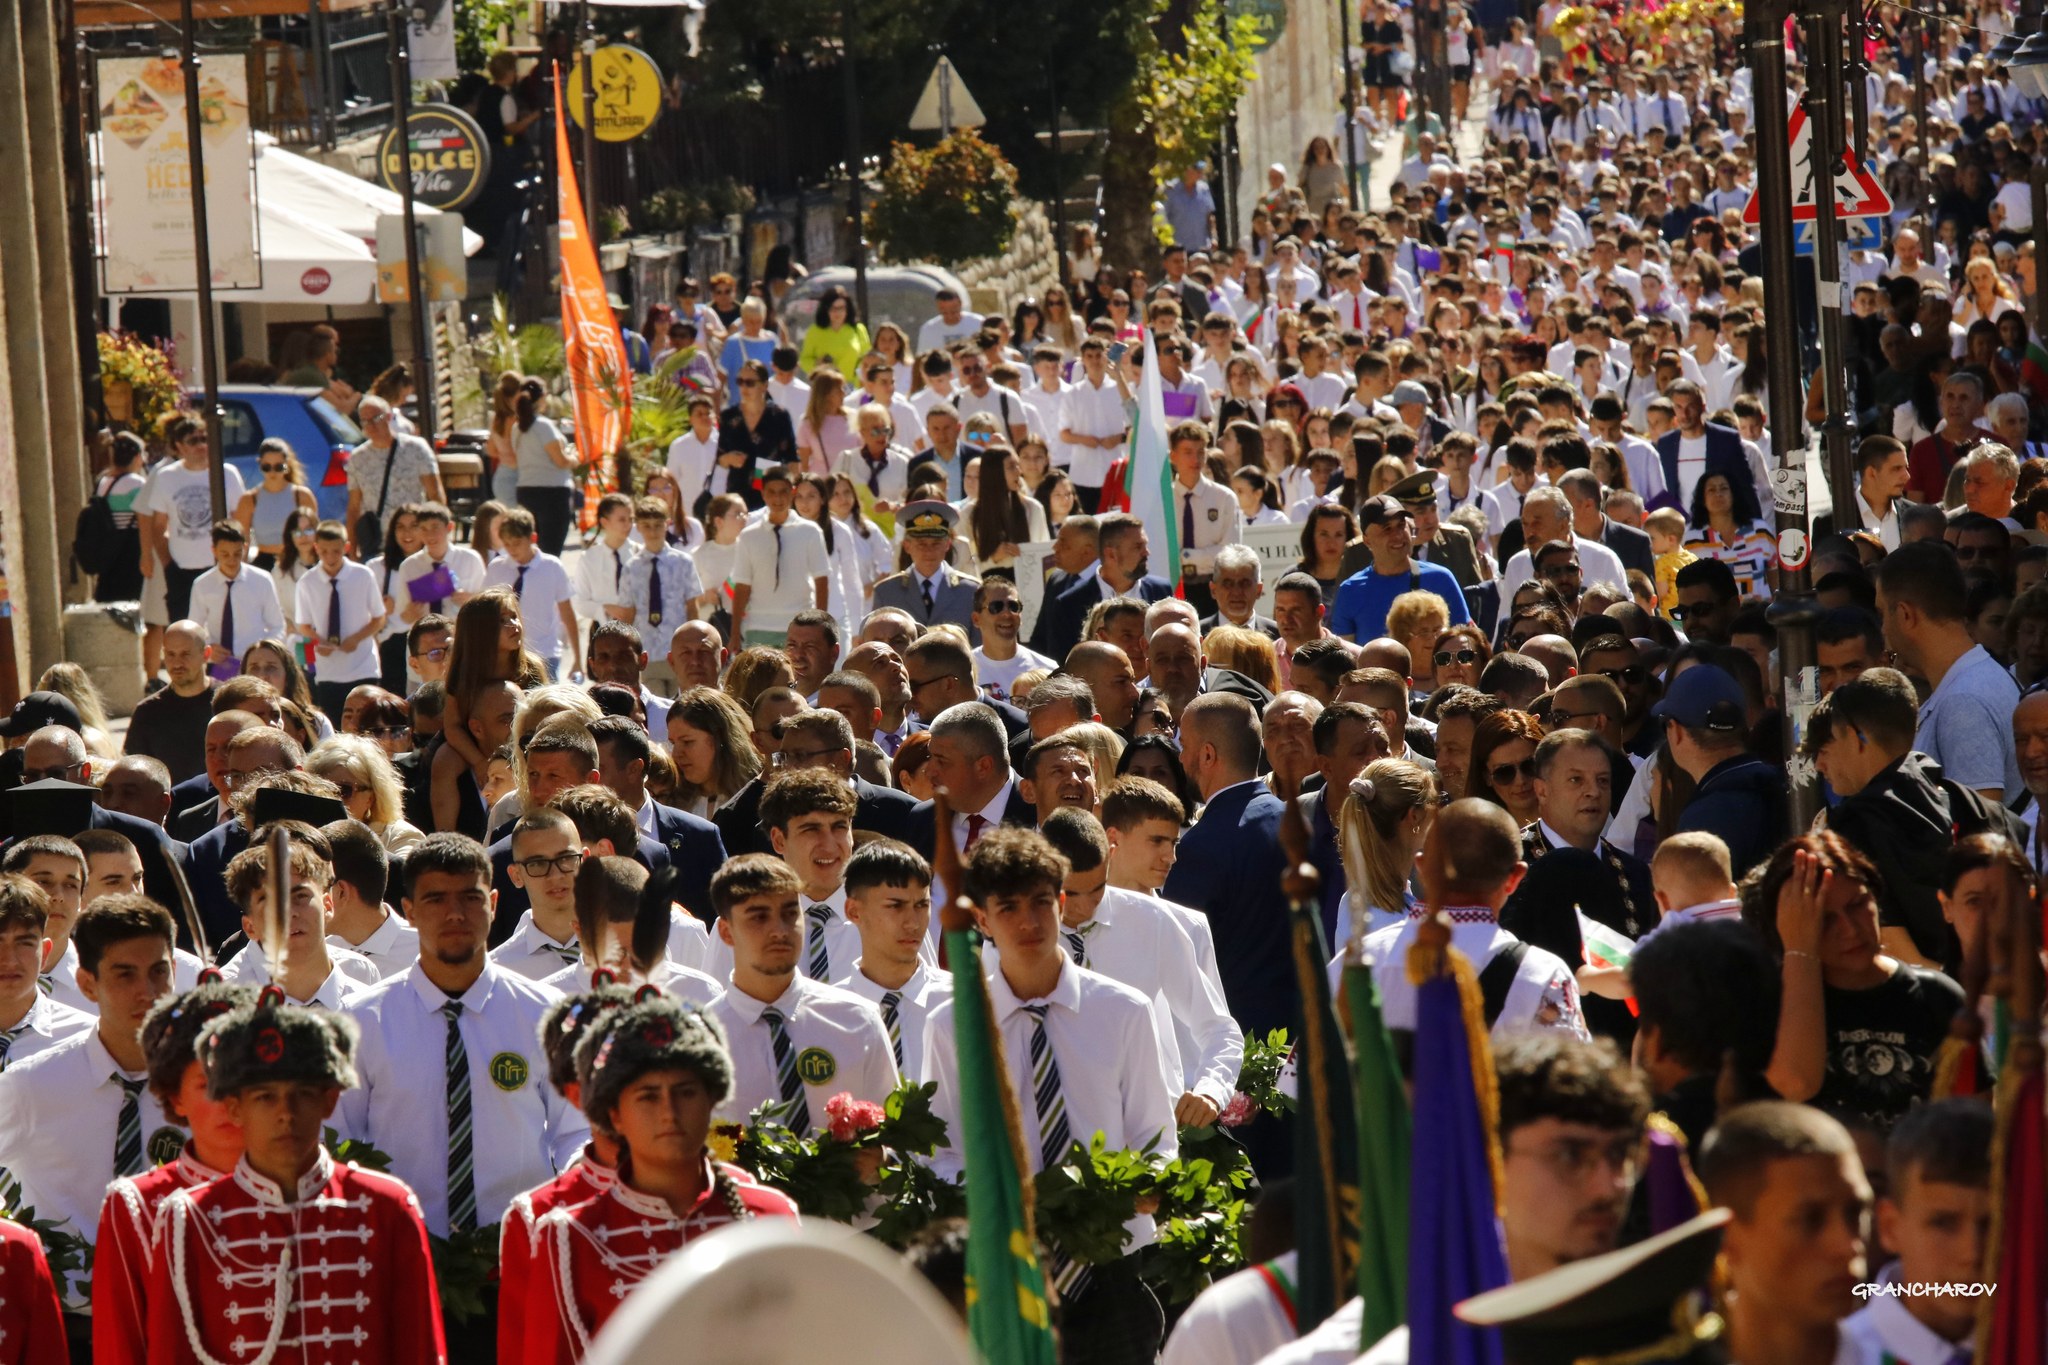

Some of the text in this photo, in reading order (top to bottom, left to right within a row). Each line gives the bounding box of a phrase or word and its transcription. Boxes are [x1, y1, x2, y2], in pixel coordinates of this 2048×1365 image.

[387, 150, 475, 174] DOLCE
[411, 166, 452, 195] Vita
[1260, 545, 1302, 559] ЧНА
